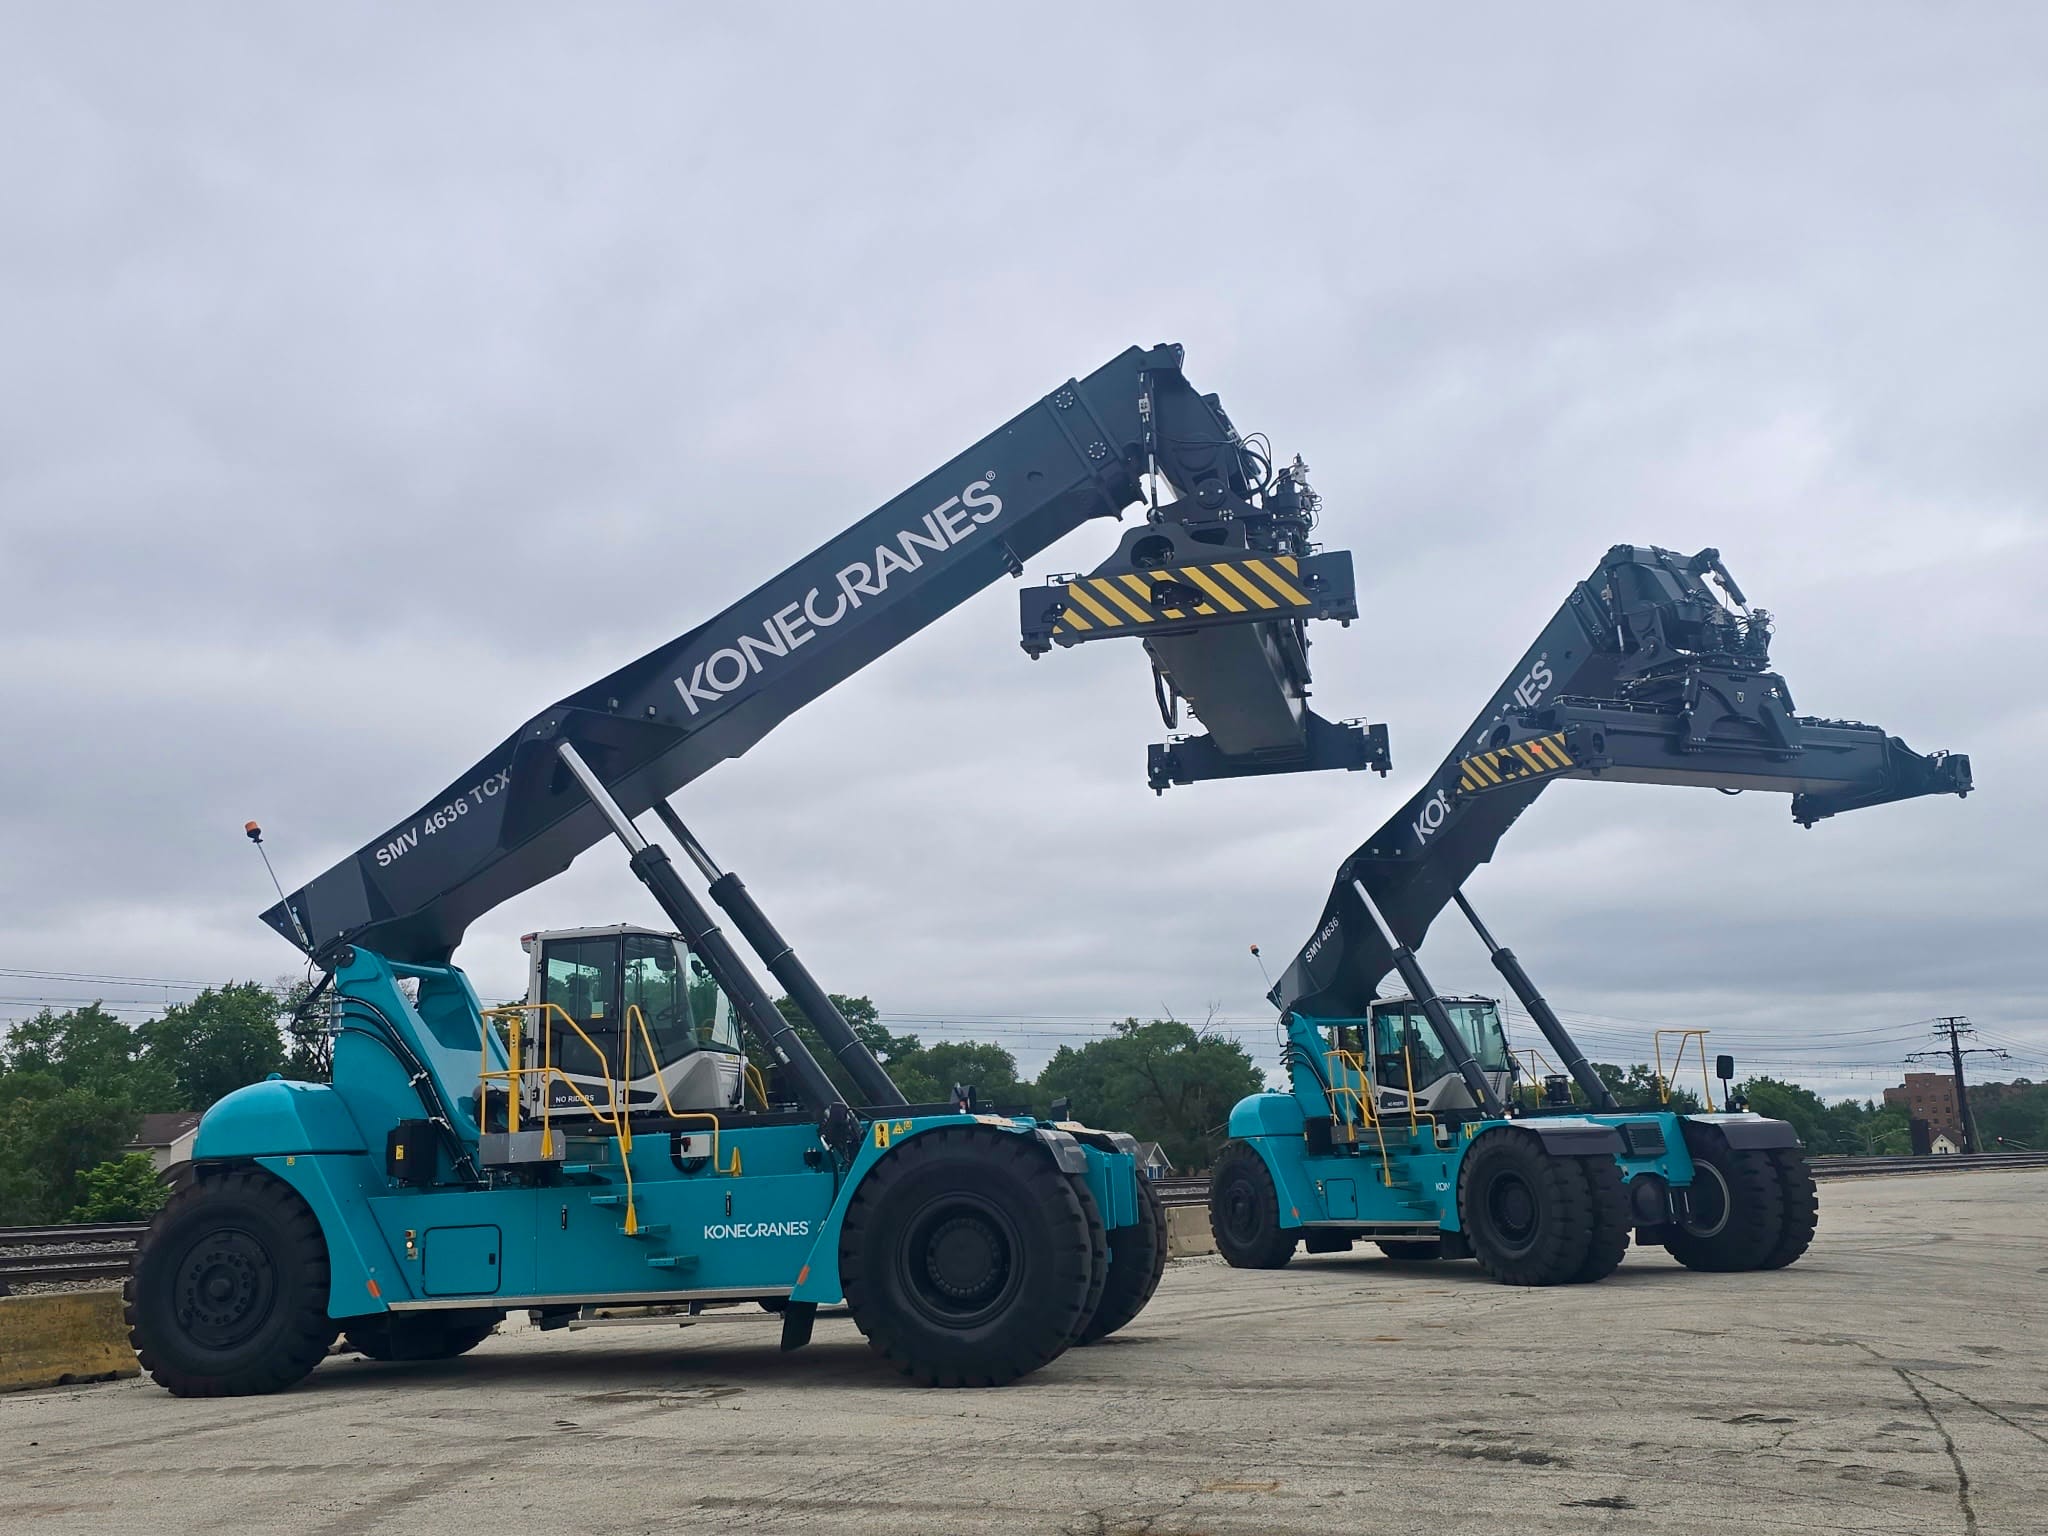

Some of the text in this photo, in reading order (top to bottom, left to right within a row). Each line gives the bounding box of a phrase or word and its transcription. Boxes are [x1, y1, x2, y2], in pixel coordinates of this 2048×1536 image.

[674, 480, 1003, 715] KONECRANES
[375, 765, 512, 867] SMV 4636 TCX
[1305, 916, 1339, 962] SMV 4636
[568, 1094, 595, 1103] RIDRS
[704, 1221, 809, 1239] KONECRANES
